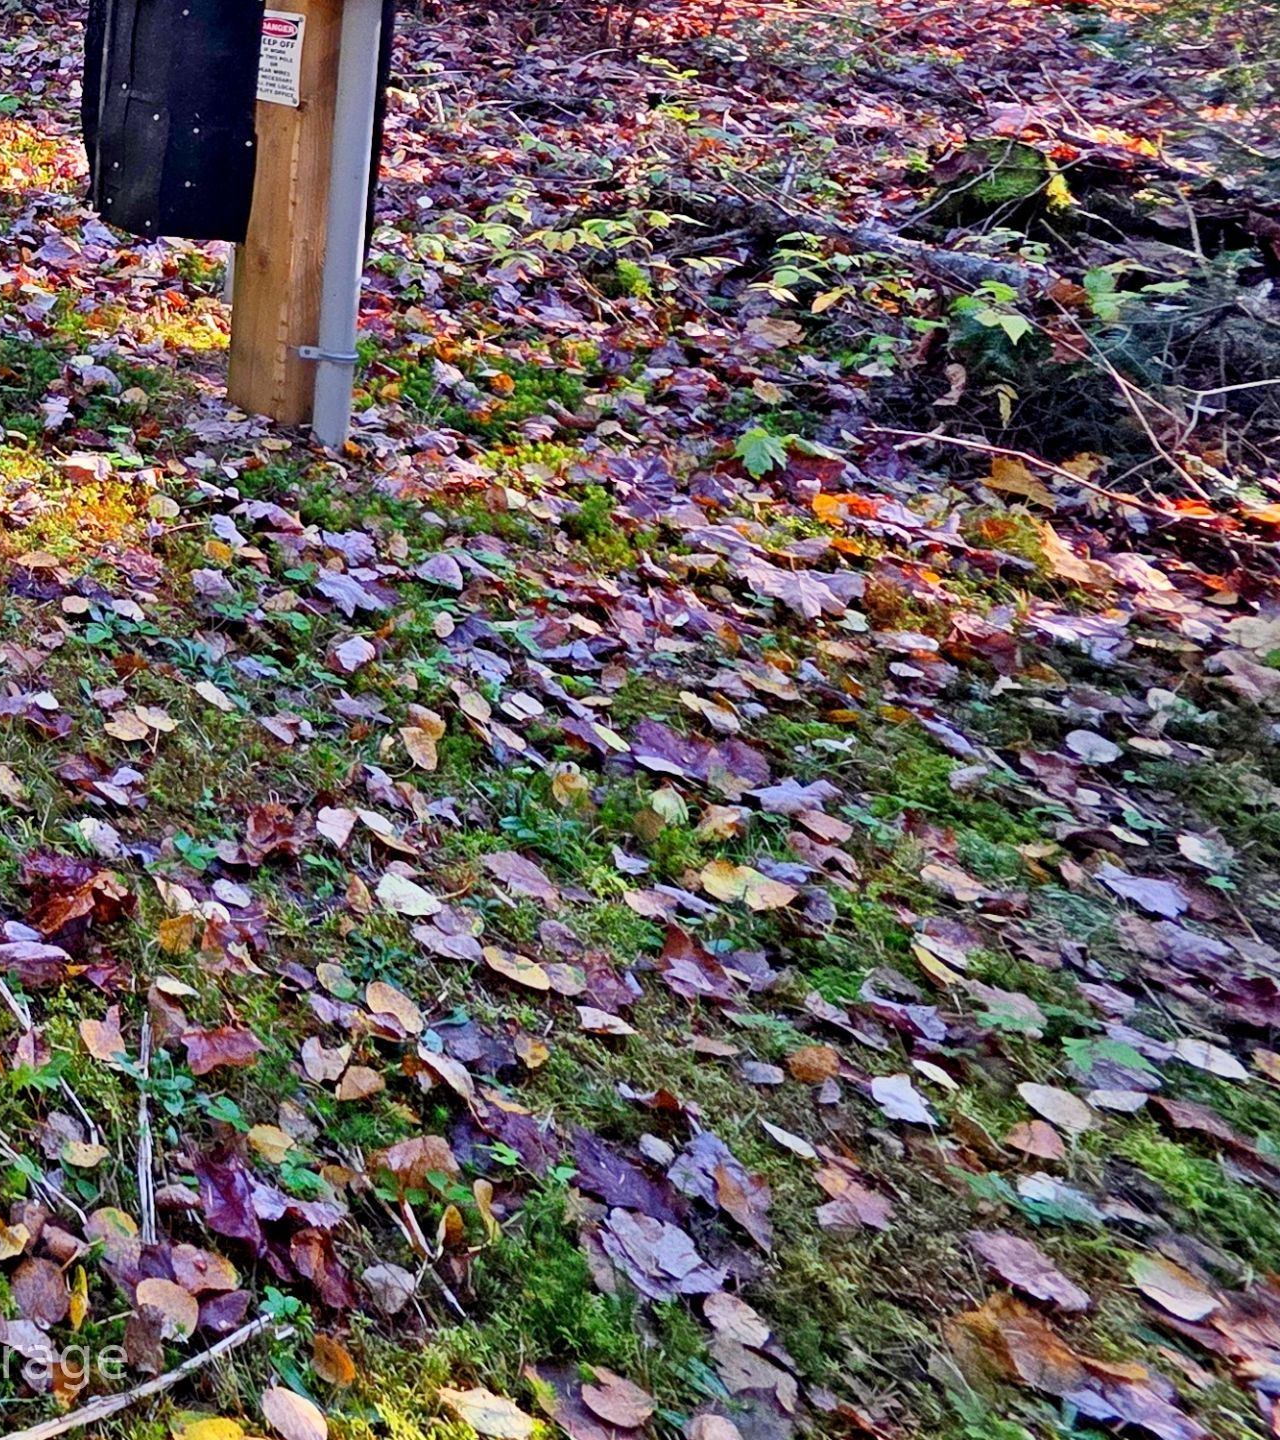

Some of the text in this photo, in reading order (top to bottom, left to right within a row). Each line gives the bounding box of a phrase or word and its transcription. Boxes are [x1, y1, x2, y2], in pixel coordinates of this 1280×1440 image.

[280, 40, 295, 48] OFF
[261, 74, 293, 83] NECESSARY
[277, 83, 296, 92] LOCAL
[274, 89, 294, 98] OFFICE
